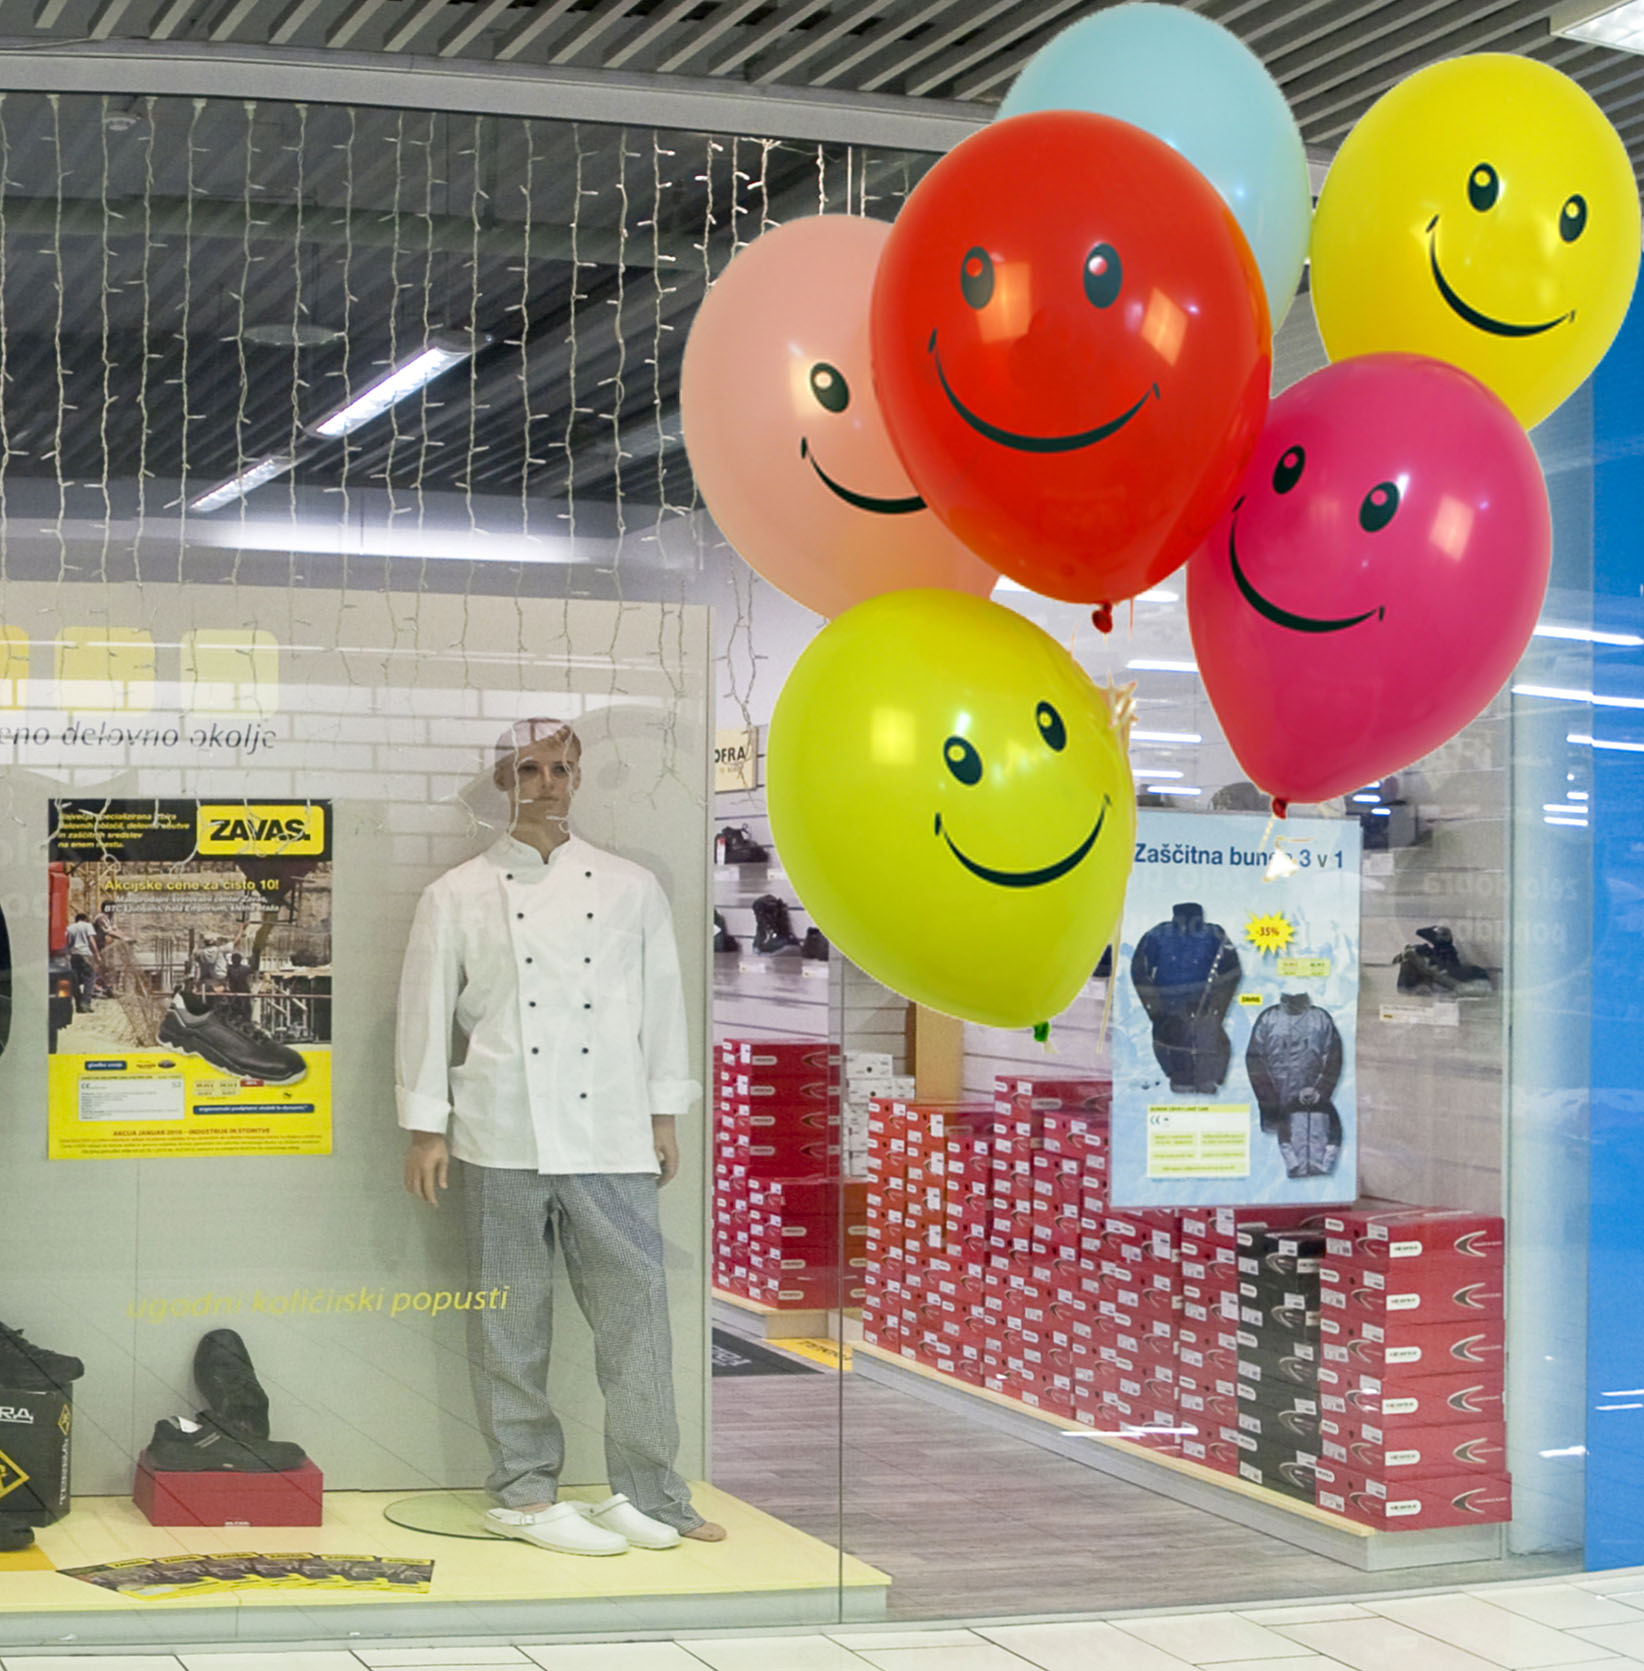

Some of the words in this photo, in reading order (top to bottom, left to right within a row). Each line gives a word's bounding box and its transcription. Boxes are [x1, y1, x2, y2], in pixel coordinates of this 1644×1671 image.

[714, 746, 746, 764] OFRA
[1134, 843, 1223, 866] Zaščitna
[1230, 846, 1292, 868] bun
[1299, 849, 1312, 868] 3
[1318, 854, 1329, 868] v
[1334, 849, 1344, 869] 1
[104, 880, 162, 892] Akcijske
[167, 880, 200, 891] cene
[261, 879, 280, 890] 10!
[390, 1285, 511, 1318] popusti
